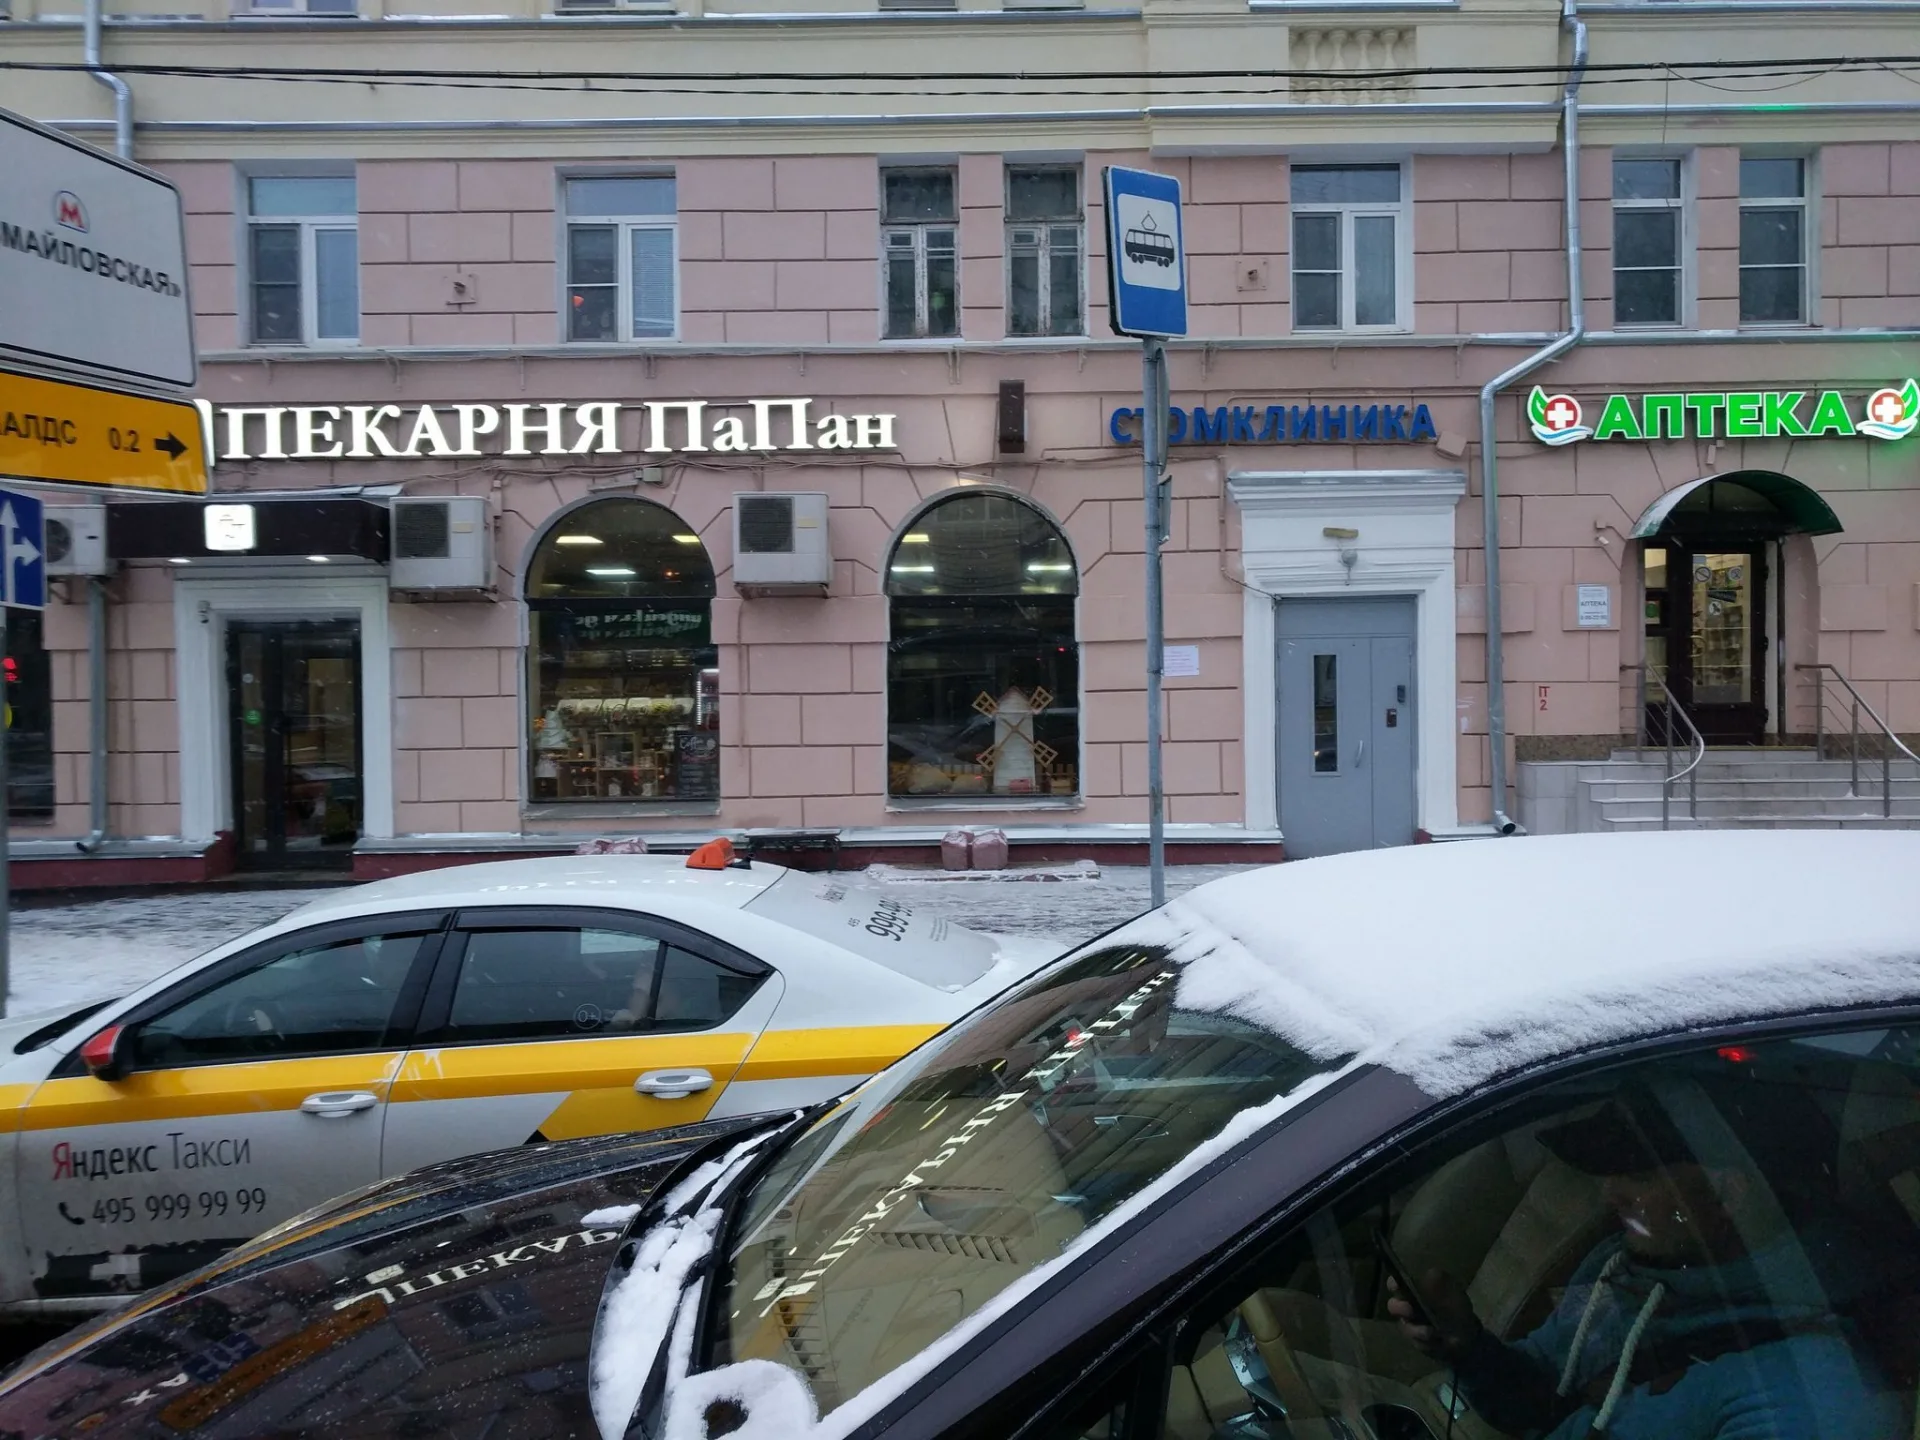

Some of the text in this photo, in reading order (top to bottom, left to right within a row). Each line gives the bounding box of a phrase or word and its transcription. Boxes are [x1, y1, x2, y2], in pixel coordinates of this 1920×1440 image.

[220, 398, 897, 461] ПЕКАРНЯ ПаПан
[1594, 391, 1857, 440] АПТЕКА
[52, 1132, 251, 1181] Яндекс Такси
[92, 1187, 266, 1225] 495 999 99 99
